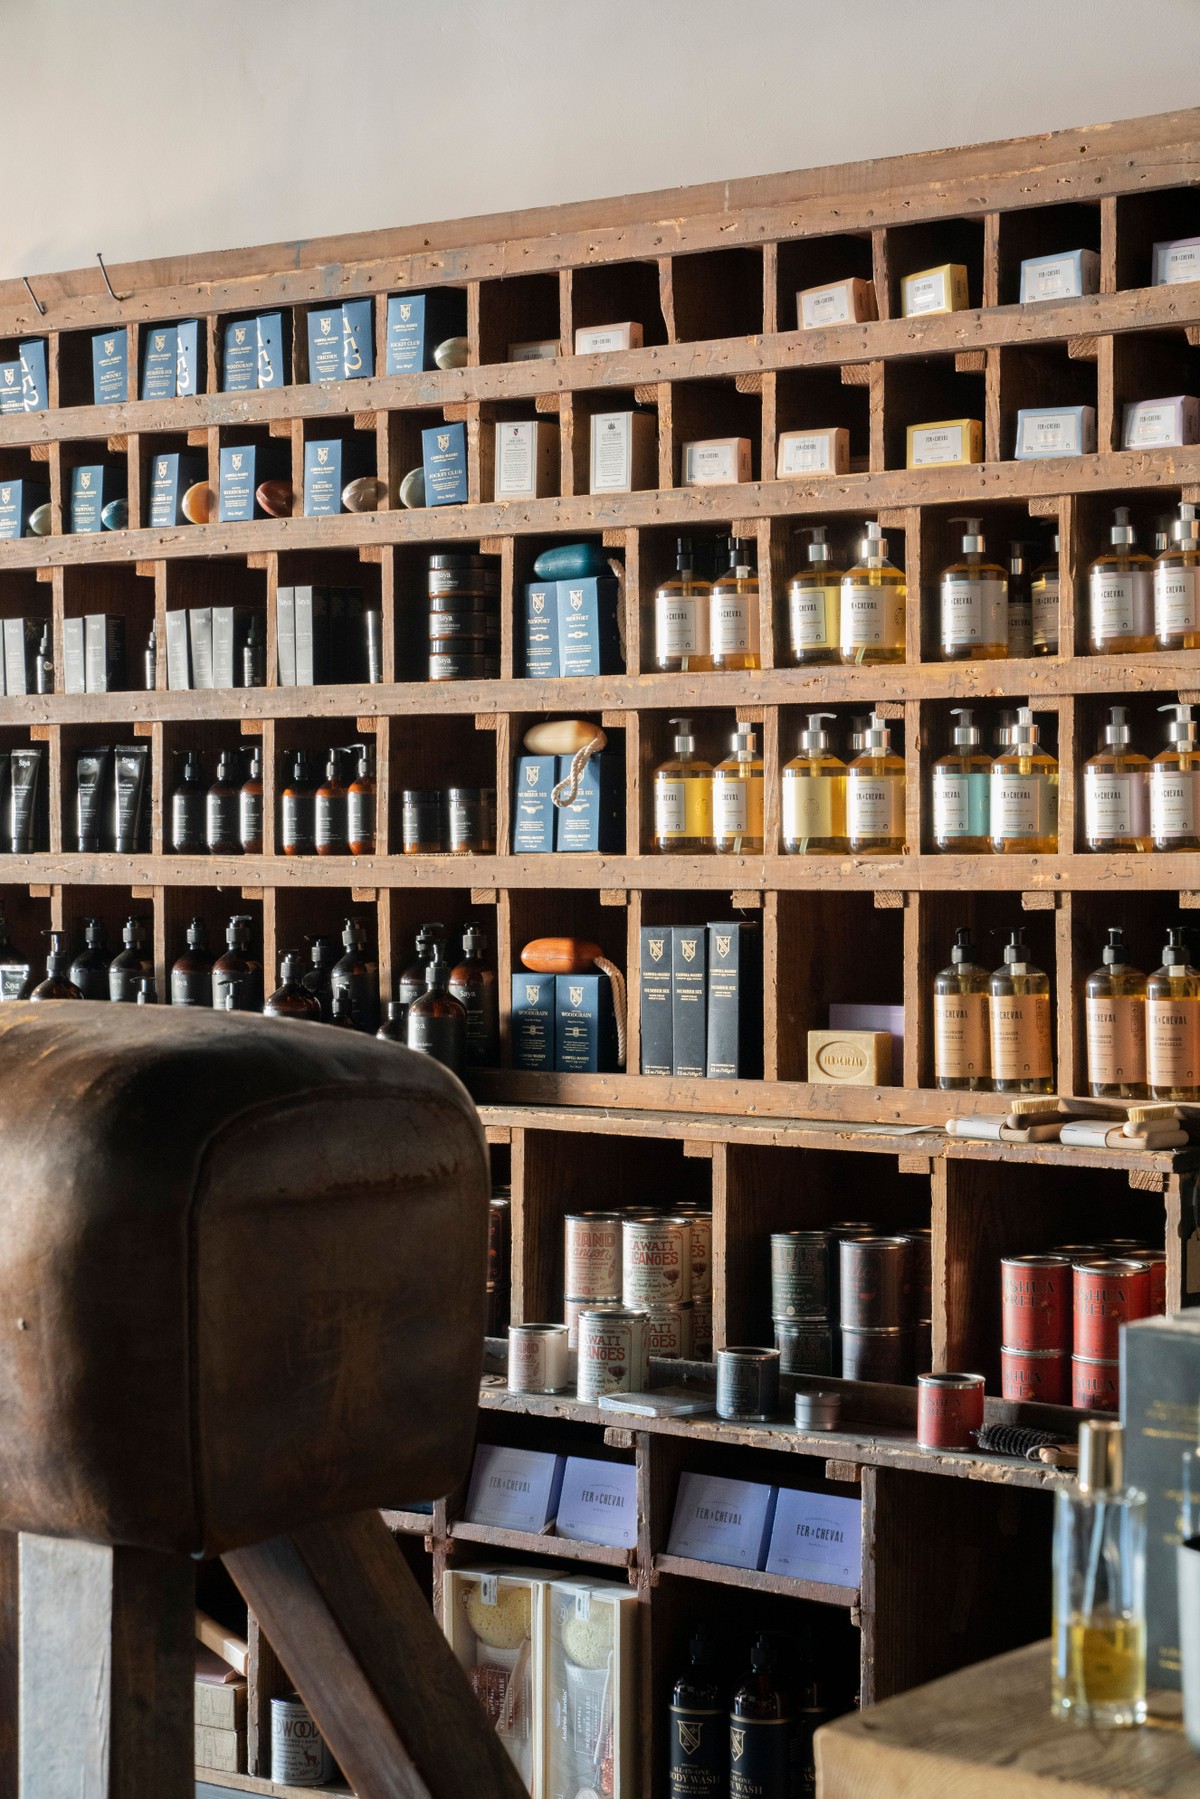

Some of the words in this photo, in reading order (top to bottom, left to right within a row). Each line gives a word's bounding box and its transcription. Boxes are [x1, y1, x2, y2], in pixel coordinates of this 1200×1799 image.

[1103, 590, 1124, 599] CHEVAL
[1165, 585, 1186, 594] CHEVAL
[857, 602, 877, 610] CHEVAL
[952, 597, 972, 605] CHEVAL
[1010, 791, 1031, 799] CHEVAL
[1101, 791, 1121, 799] CHEVAL
[1163, 789, 1184, 798] CHEVAL
[4, 981, 20, 991] Saya
[459, 990, 477, 998] Saya
[945, 1009, 969, 1019] CHEVAL
[1000, 1010, 1023, 1020] CHEVAL
[1094, 1013, 1117, 1023] CHEVAL
[1161, 1015, 1188, 1025] CHEVAL
[573, 1232, 616, 1248] RAND
[632, 1240, 674, 1251] AWAI'I
[573, 1248, 612, 1261] anyon
[783, 1248, 818, 1261] UIR
[779, 1260, 825, 1274] OODS
[1009, 1279, 1056, 1293] SHUA
[1010, 1294, 1040, 1307] REE
[1079, 1287, 1126, 1303] SHUA
[1080, 1303, 1108, 1317] REE
[1004, 1369, 1042, 1384] SHUA
[1075, 1375, 1117, 1392] SHUA
[1004, 1383, 1029, 1397] REE
[927, 1397, 961, 1407] SHUA
[1076, 1391, 1103, 1403] REE
[928, 1407, 950, 1417] REE
[490, 1477, 502, 1488] FER
[506, 1479, 531, 1494] CHEVAL
[581, 1490, 594, 1502] FER
[599, 1493, 625, 1508] CHEVAL
[696, 1507, 709, 1520] FER
[714, 1509, 742, 1526] CHEVAL
[796, 1523, 810, 1537] FER
[815, 1527, 844, 1543] CHEVAL
[673, 1766, 711, 1776] ALL-IN-ONE
[670, 1772, 688, 1783] ODY
[690, 1775, 720, 1786] WASH
[735, 1782, 762, 1795] WASH
